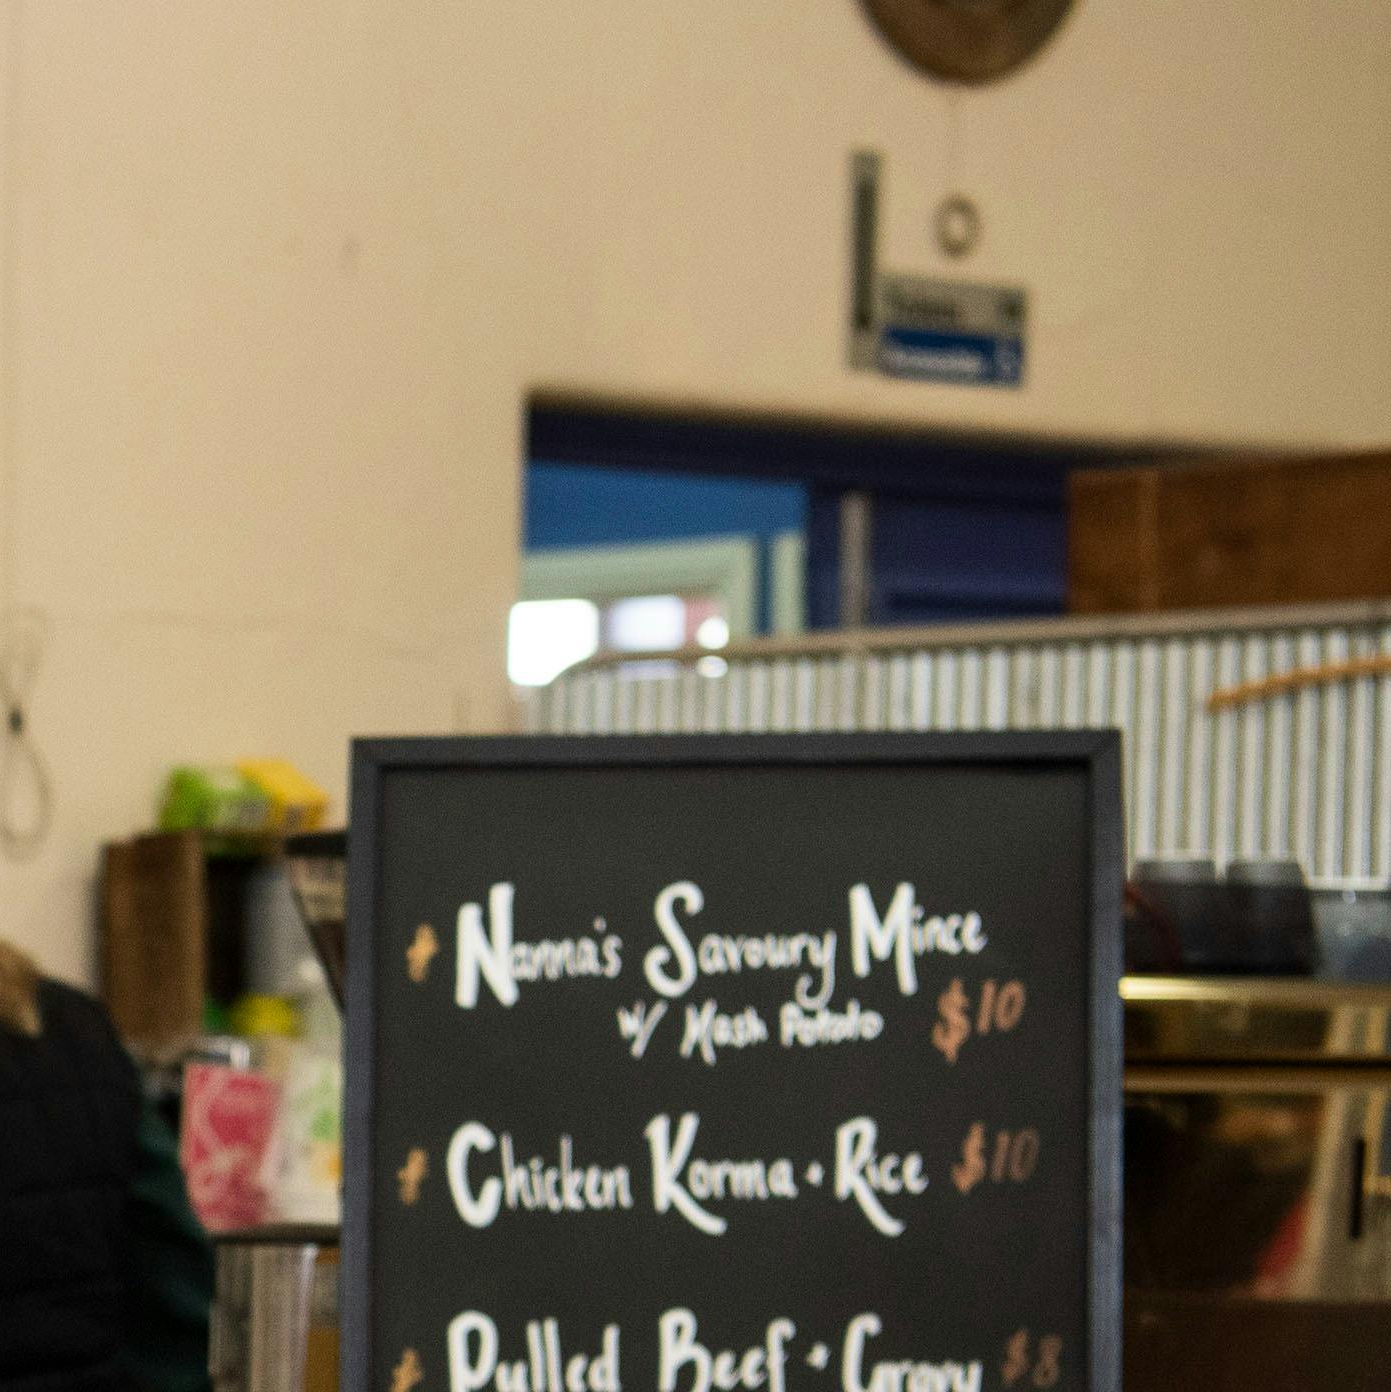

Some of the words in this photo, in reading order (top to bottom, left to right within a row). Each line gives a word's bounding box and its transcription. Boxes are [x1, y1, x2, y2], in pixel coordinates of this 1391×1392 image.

[456, 883, 622, 1009] Nanna's
[643, 881, 836, 1009] Savoury
[849, 882, 988, 996] Mince
[931, 978, 1027, 1065] $10
[680, 1003, 768, 1066] Mash
[779, 1001, 884, 1049] Potato
[447, 1121, 633, 1229] Chicken
[643, 1112, 799, 1237] Korma
[836, 1116, 929, 1238] Rice
[952, 1121, 1040, 1194] $10
[1000, 1328, 1063, 1389] $8
